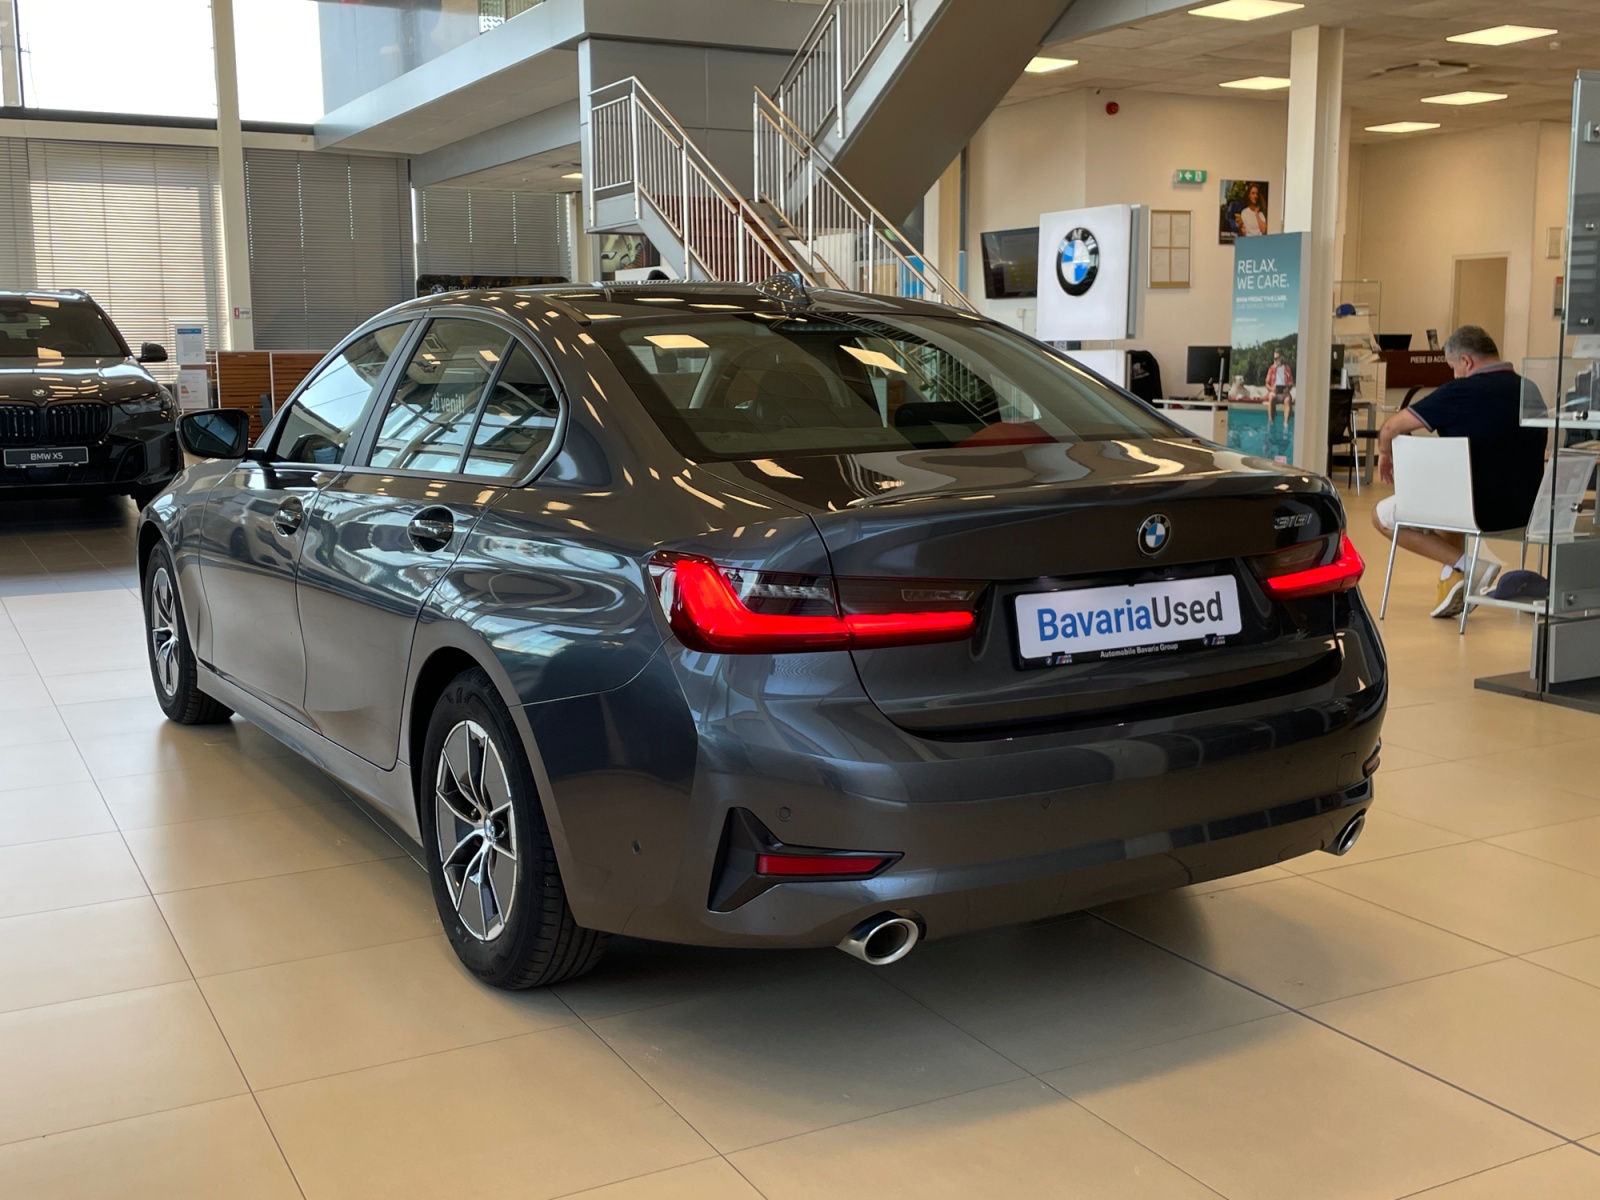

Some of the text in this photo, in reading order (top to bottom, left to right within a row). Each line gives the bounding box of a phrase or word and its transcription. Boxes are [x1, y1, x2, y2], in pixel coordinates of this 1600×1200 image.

[1237, 258, 1278, 274] RELAX.
[1236, 273, 1290, 290] WE CARE.
[30, 451, 64, 461] BMW X5
[1100, 643, 1179, 658] Automobile Bavaria Group
